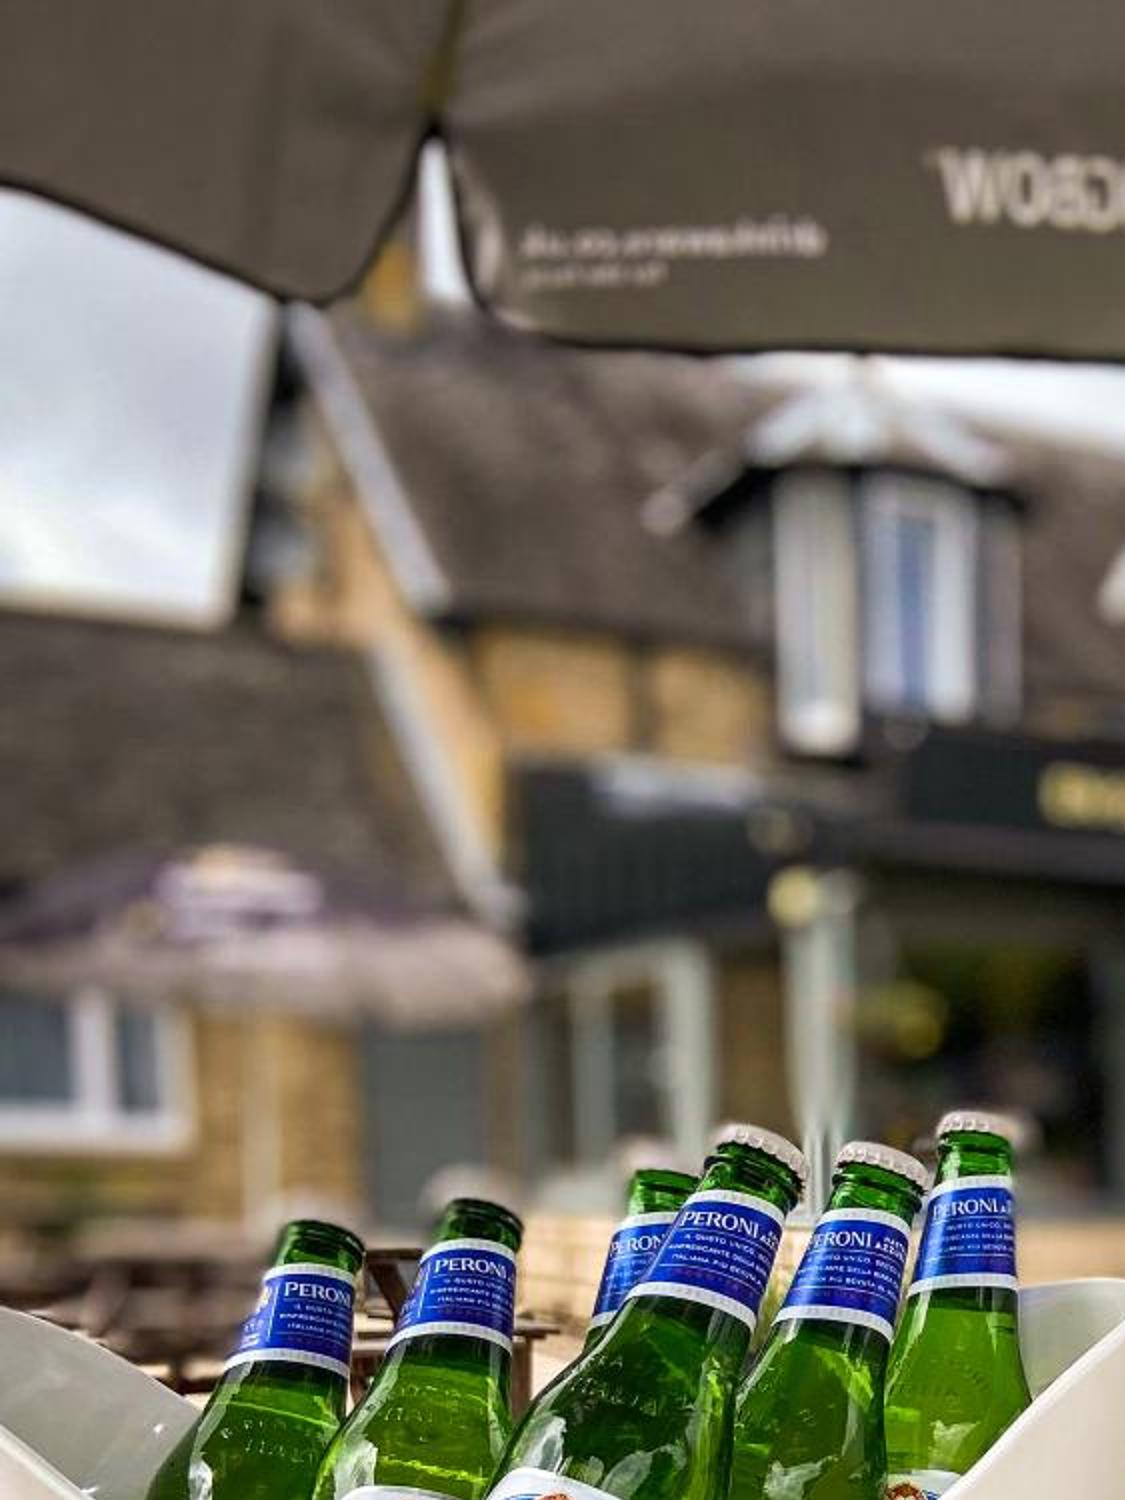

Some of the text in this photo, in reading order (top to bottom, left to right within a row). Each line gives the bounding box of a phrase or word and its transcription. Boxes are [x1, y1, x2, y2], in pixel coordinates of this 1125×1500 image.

[680, 1211, 759, 1239] PERONI
[813, 1230, 873, 1249] ERONI
[434, 1257, 507, 1279] PERONI
